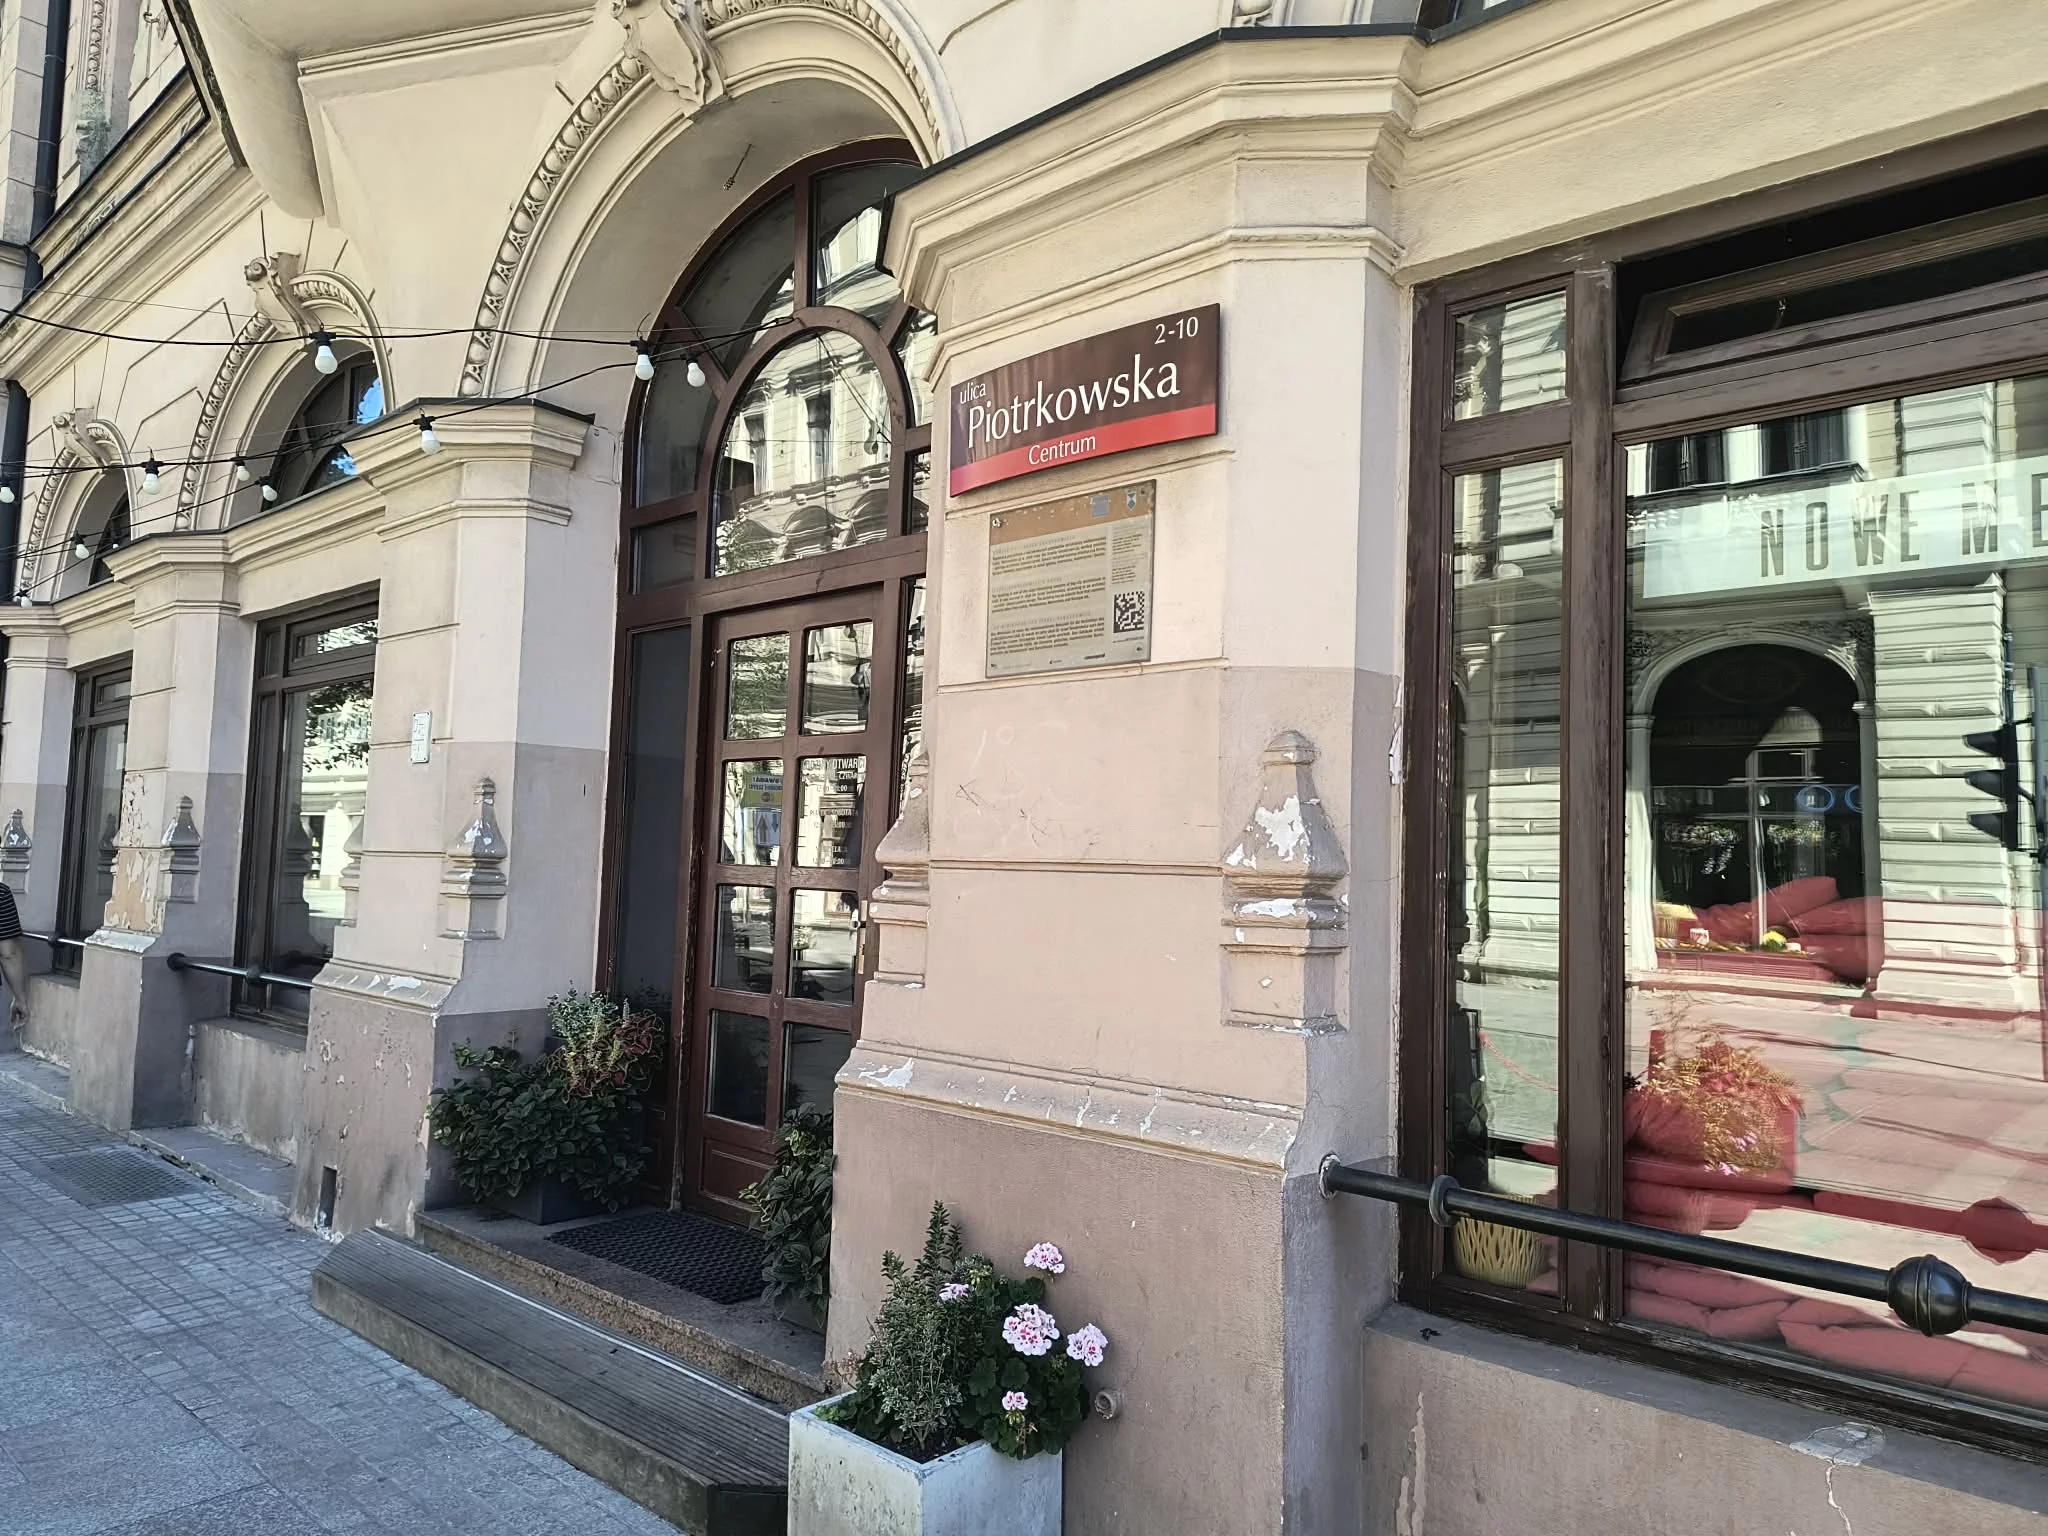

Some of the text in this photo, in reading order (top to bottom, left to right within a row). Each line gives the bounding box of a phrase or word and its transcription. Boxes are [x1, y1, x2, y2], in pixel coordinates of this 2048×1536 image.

[1154, 316, 1199, 344] 2-10
[959, 381, 987, 405] ulica
[968, 353, 1180, 449] Piotrkowska
[1028, 435, 1097, 466] Centrum
[1760, 490, 1921, 578] NOWE
